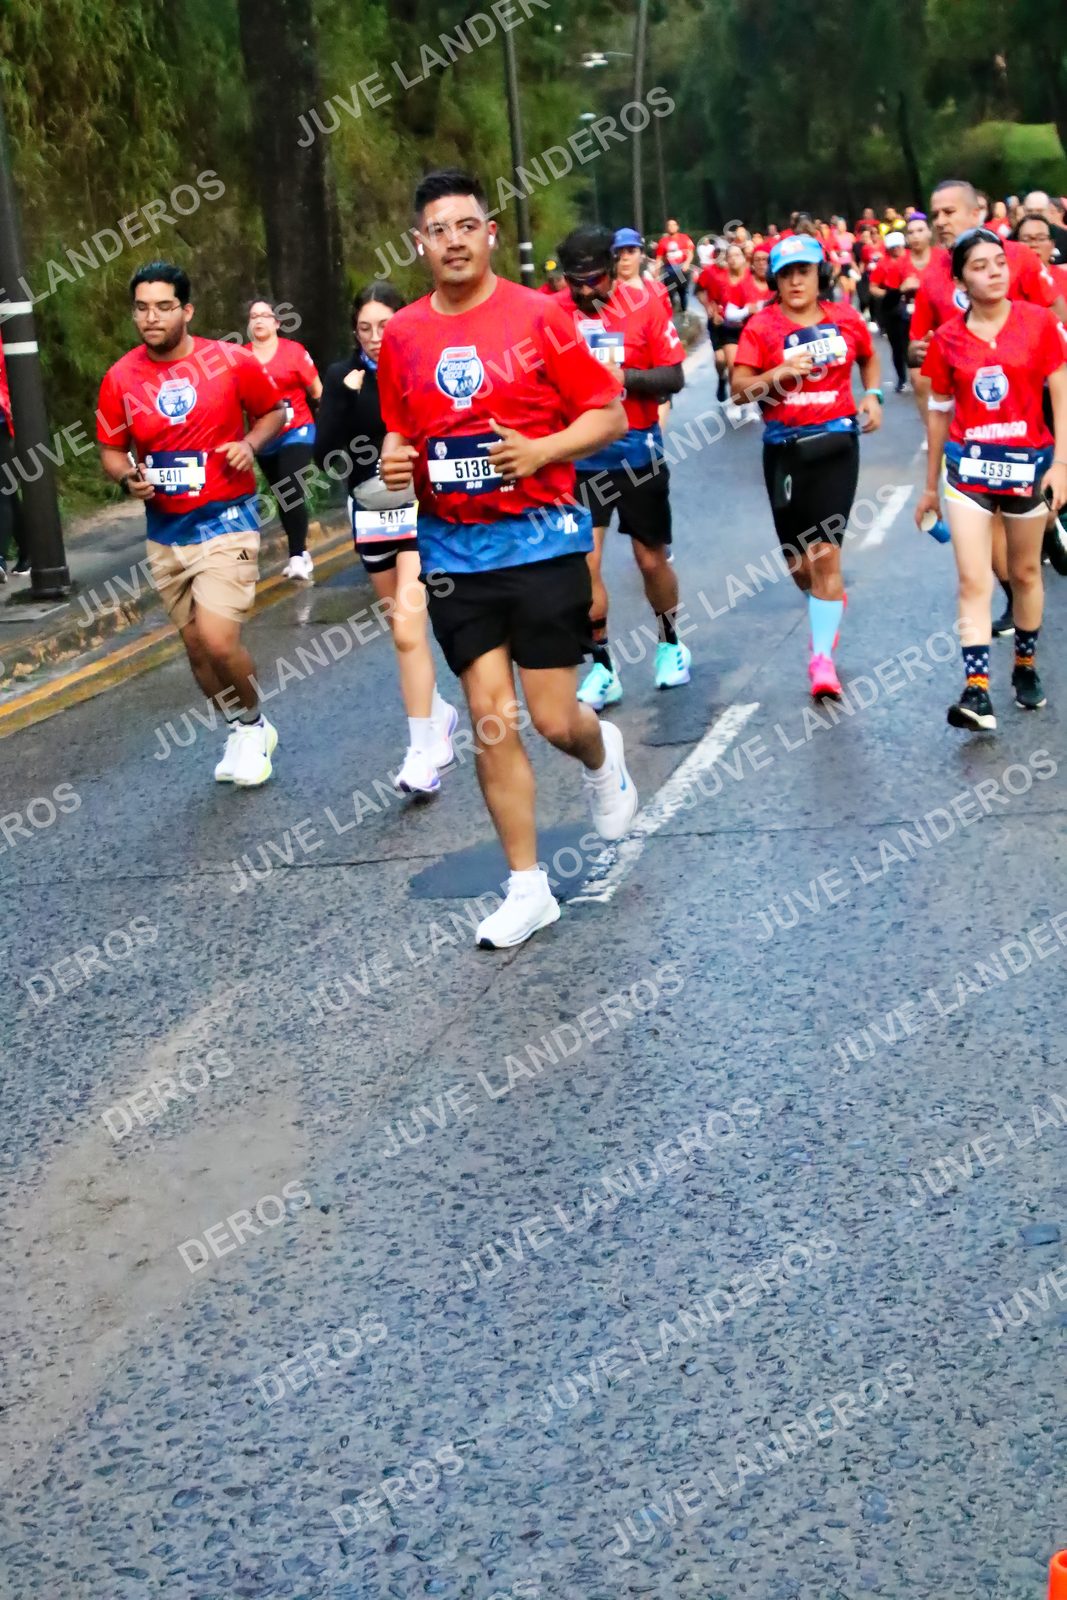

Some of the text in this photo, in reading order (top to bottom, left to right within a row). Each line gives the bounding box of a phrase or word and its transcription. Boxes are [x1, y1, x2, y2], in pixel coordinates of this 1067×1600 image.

[455, 459, 491, 478] 5138
[981, 462, 1012, 478] 4533
[159, 470, 182, 483] 5411
[379, 510, 406, 524] 5412
